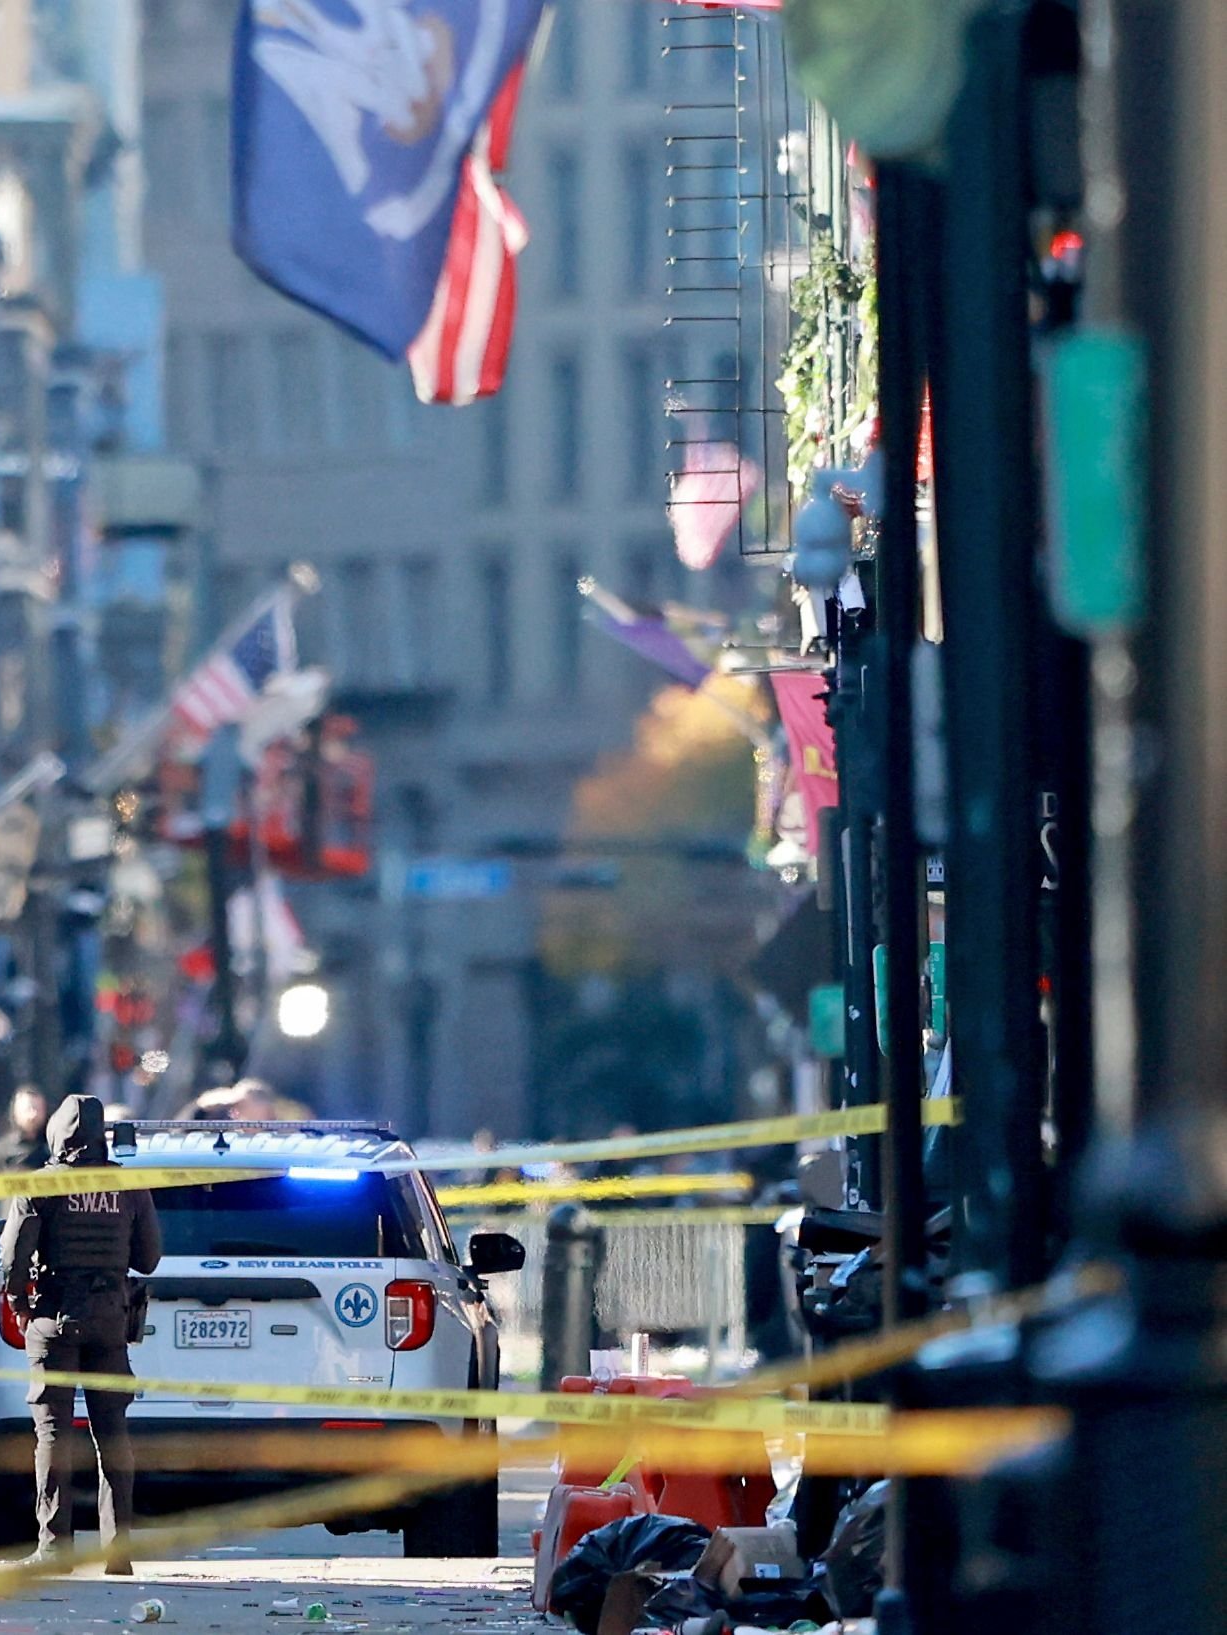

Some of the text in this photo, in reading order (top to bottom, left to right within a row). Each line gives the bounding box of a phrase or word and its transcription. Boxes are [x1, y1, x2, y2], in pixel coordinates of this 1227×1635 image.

[237, 1260, 384, 1269] NEW ORLEANS POLICE
[189, 1321, 248, 1338] 282972
